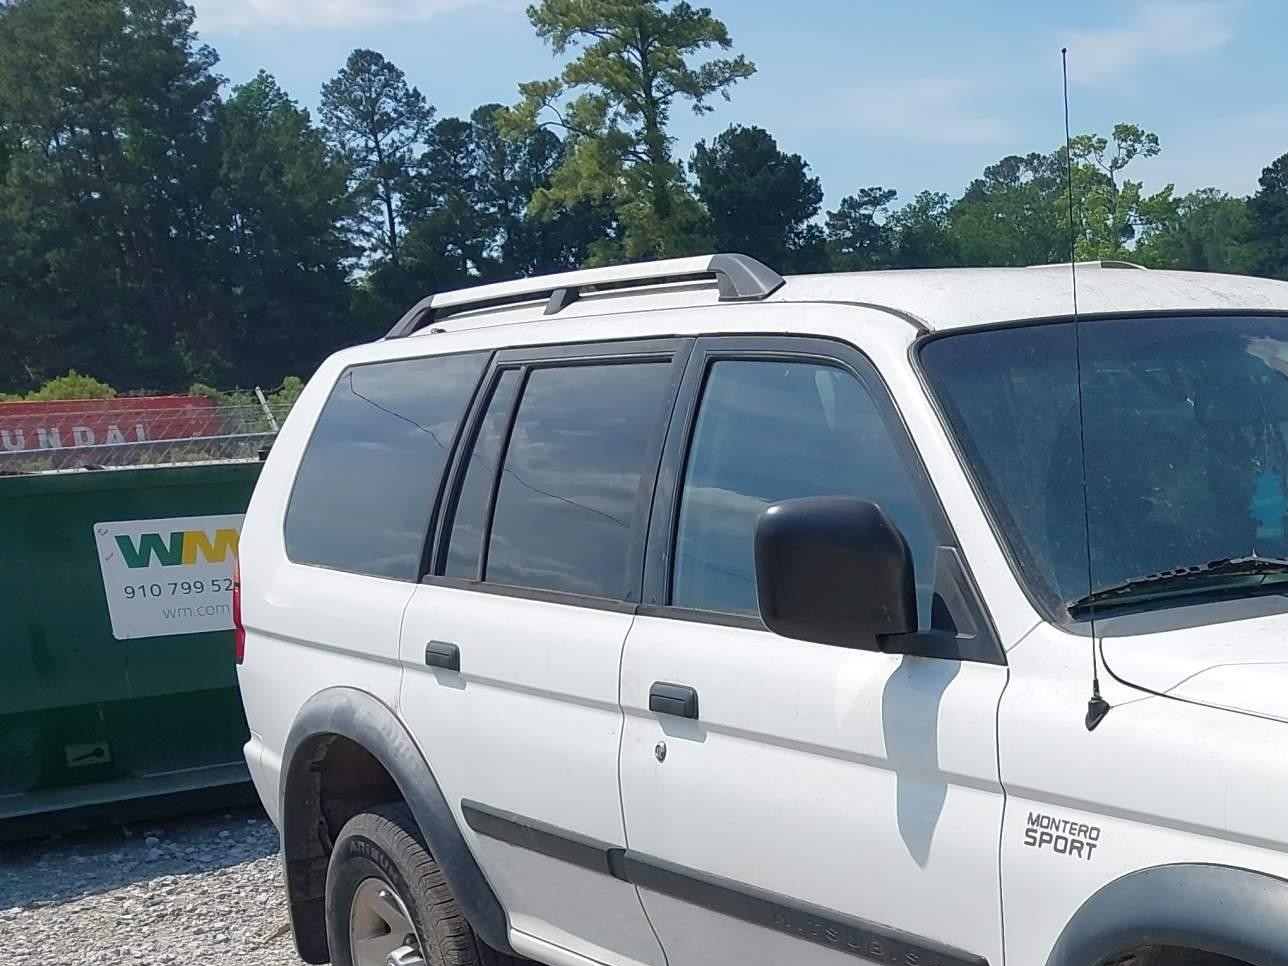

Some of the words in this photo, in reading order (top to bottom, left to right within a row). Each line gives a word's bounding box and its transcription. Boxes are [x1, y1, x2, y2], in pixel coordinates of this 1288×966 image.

[114, 528, 240, 569] WM
[124, 583, 162, 599] 910
[167, 580, 204, 596] 799
[162, 603, 230, 619] wm.com
[1027, 811, 1101, 841] MONTERO
[1024, 827, 1097, 861] SPORT
